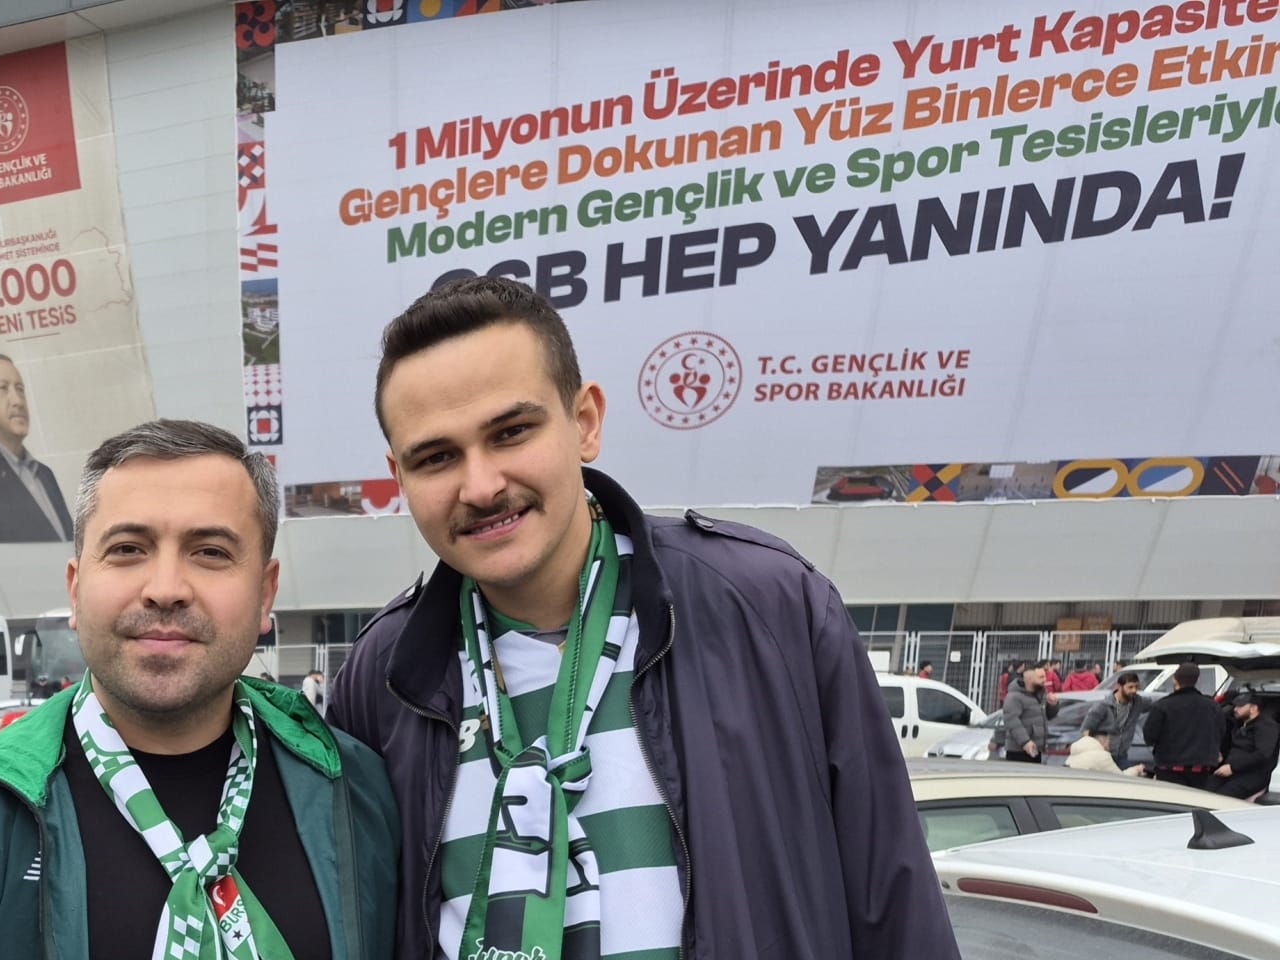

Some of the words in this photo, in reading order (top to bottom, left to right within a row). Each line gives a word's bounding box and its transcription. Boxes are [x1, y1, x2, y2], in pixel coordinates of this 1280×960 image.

[32, 153, 48, 167] VE
[338, 161, 548, 226] Gençlere
[558, 121, 782, 184] Dokunan
[794, 98, 893, 145] Yüz
[903, 64, 1139, 130] Binlerce
[390, 133, 406, 169] 1
[416, 95, 633, 165] Milyonun
[643, 66, 881, 120] Üzerinde
[894, 25, 1021, 78] Yurt
[1030, 0, 1280, 57] Kapasite
[387, 207, 567, 263] Modern
[577, 167, 765, 227] Gençlik
[773, 163, 836, 198] ve
[846, 141, 980, 193] Spor
[990, 86, 1280, 167] Tesisleriyl
[603, 222, 777, 303] HEP
[792, 152, 1246, 275] YANINDA!
[754, 382, 821, 403] SPOR
[827, 374, 966, 401] BAKANLIĞI
[758, 355, 802, 375] T.C.
[811, 348, 928, 378] GENÇLİK
[937, 349, 971, 370] VE
